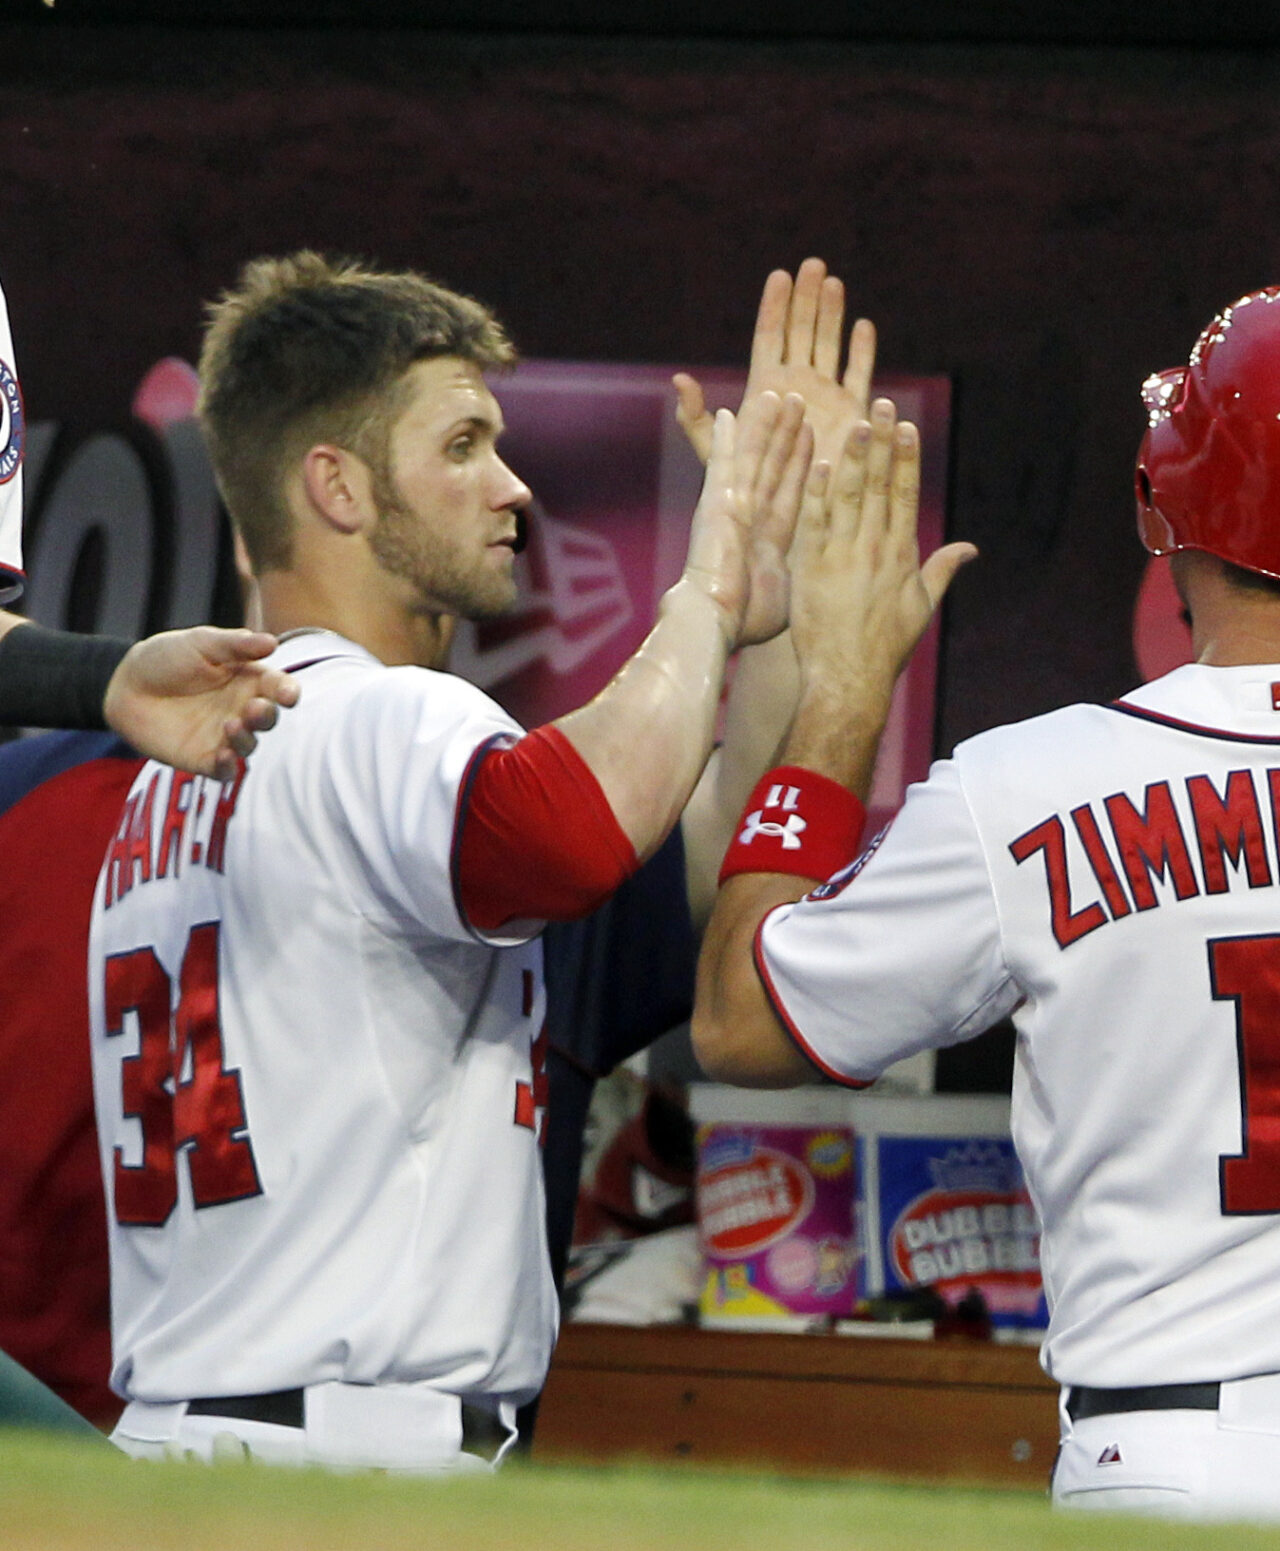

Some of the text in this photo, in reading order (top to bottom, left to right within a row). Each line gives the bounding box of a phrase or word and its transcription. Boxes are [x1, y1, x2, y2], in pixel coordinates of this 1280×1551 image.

[764, 784, 802, 812] 11
[104, 918, 265, 1229] 34
[904, 1202, 1041, 1250] DUBBL
[911, 1236, 1042, 1283] BUBBL
